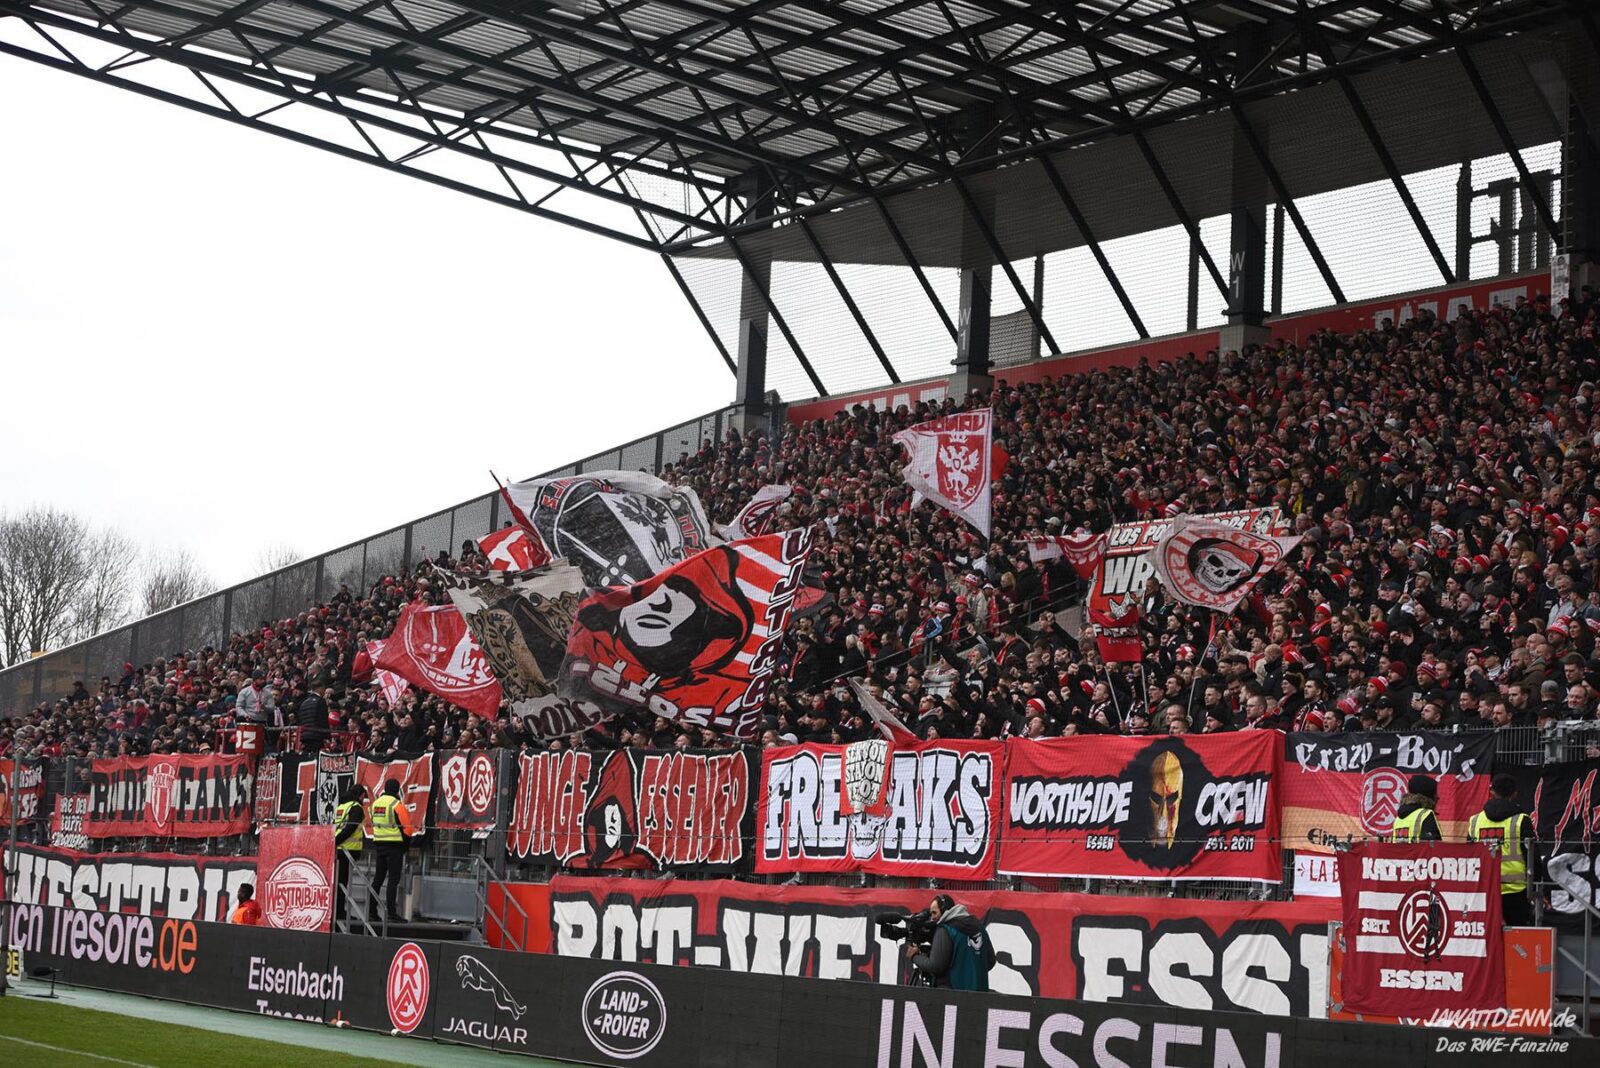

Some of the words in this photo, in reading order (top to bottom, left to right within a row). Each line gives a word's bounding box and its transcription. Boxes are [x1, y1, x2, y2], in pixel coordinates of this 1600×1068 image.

[1229, 250, 1246, 273] W
[638, 750, 749, 865] ESSENER
[1195, 778, 1269, 826] CREW
[1086, 834, 1115, 851] ESSEN
[1230, 836, 1255, 852] 2011
[1361, 856, 1482, 882] KATEGORIE
[1361, 917, 1391, 934] SEIT
[1453, 920, 1486, 937] 2015
[247, 955, 344, 1002] Eisenbach
[1379, 967, 1464, 992] ESSEN
[600, 989, 640, 1013] LAND
[442, 1015, 528, 1046] JAGUAR
[601, 1015, 651, 1040] ROVER
[877, 998, 957, 1068] IN
